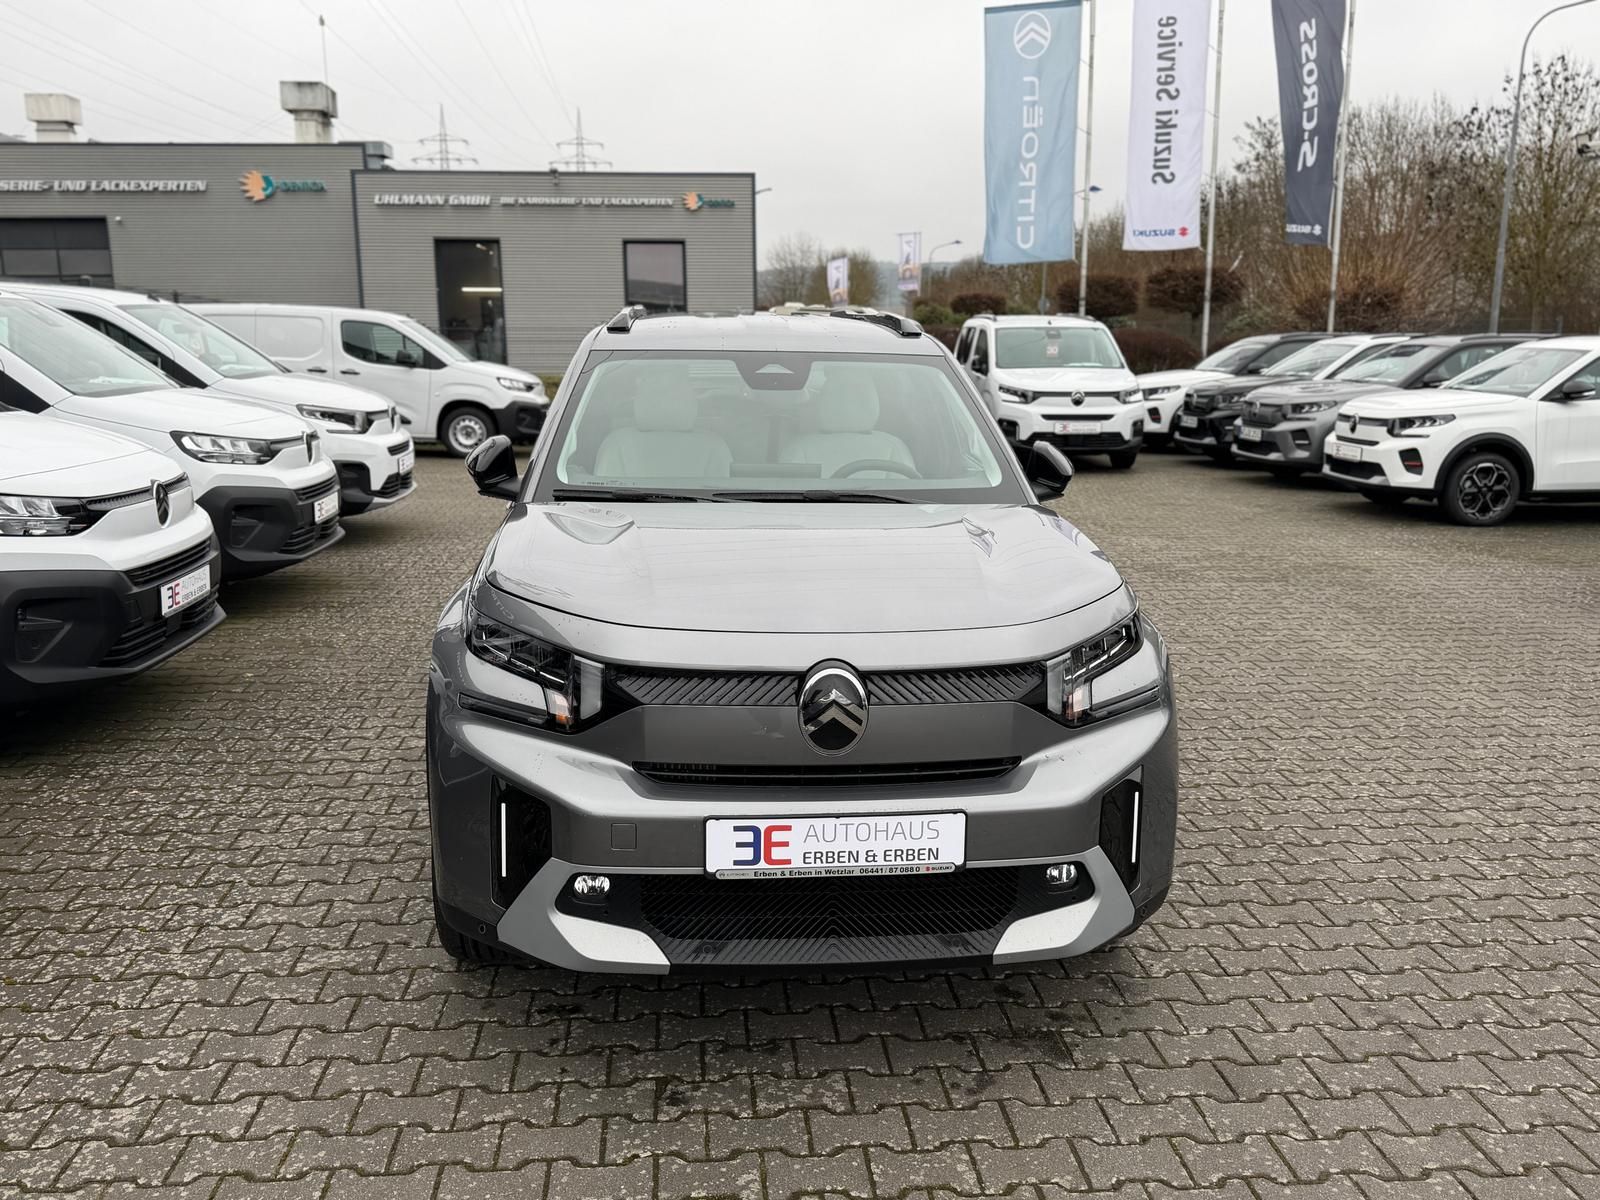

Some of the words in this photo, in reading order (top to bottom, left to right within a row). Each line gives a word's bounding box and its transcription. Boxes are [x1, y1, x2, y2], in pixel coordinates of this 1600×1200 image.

[53, 180, 87, 192] UND
[90, 179, 207, 192] LACKEXPERTEN
[374, 194, 445, 206] UHLMANN
[803, 820, 940, 843] AUTOHAUS
[802, 850, 859, 865] ERBEN
[864, 849, 878, 863] &
[883, 847, 940, 862] ERBEN
